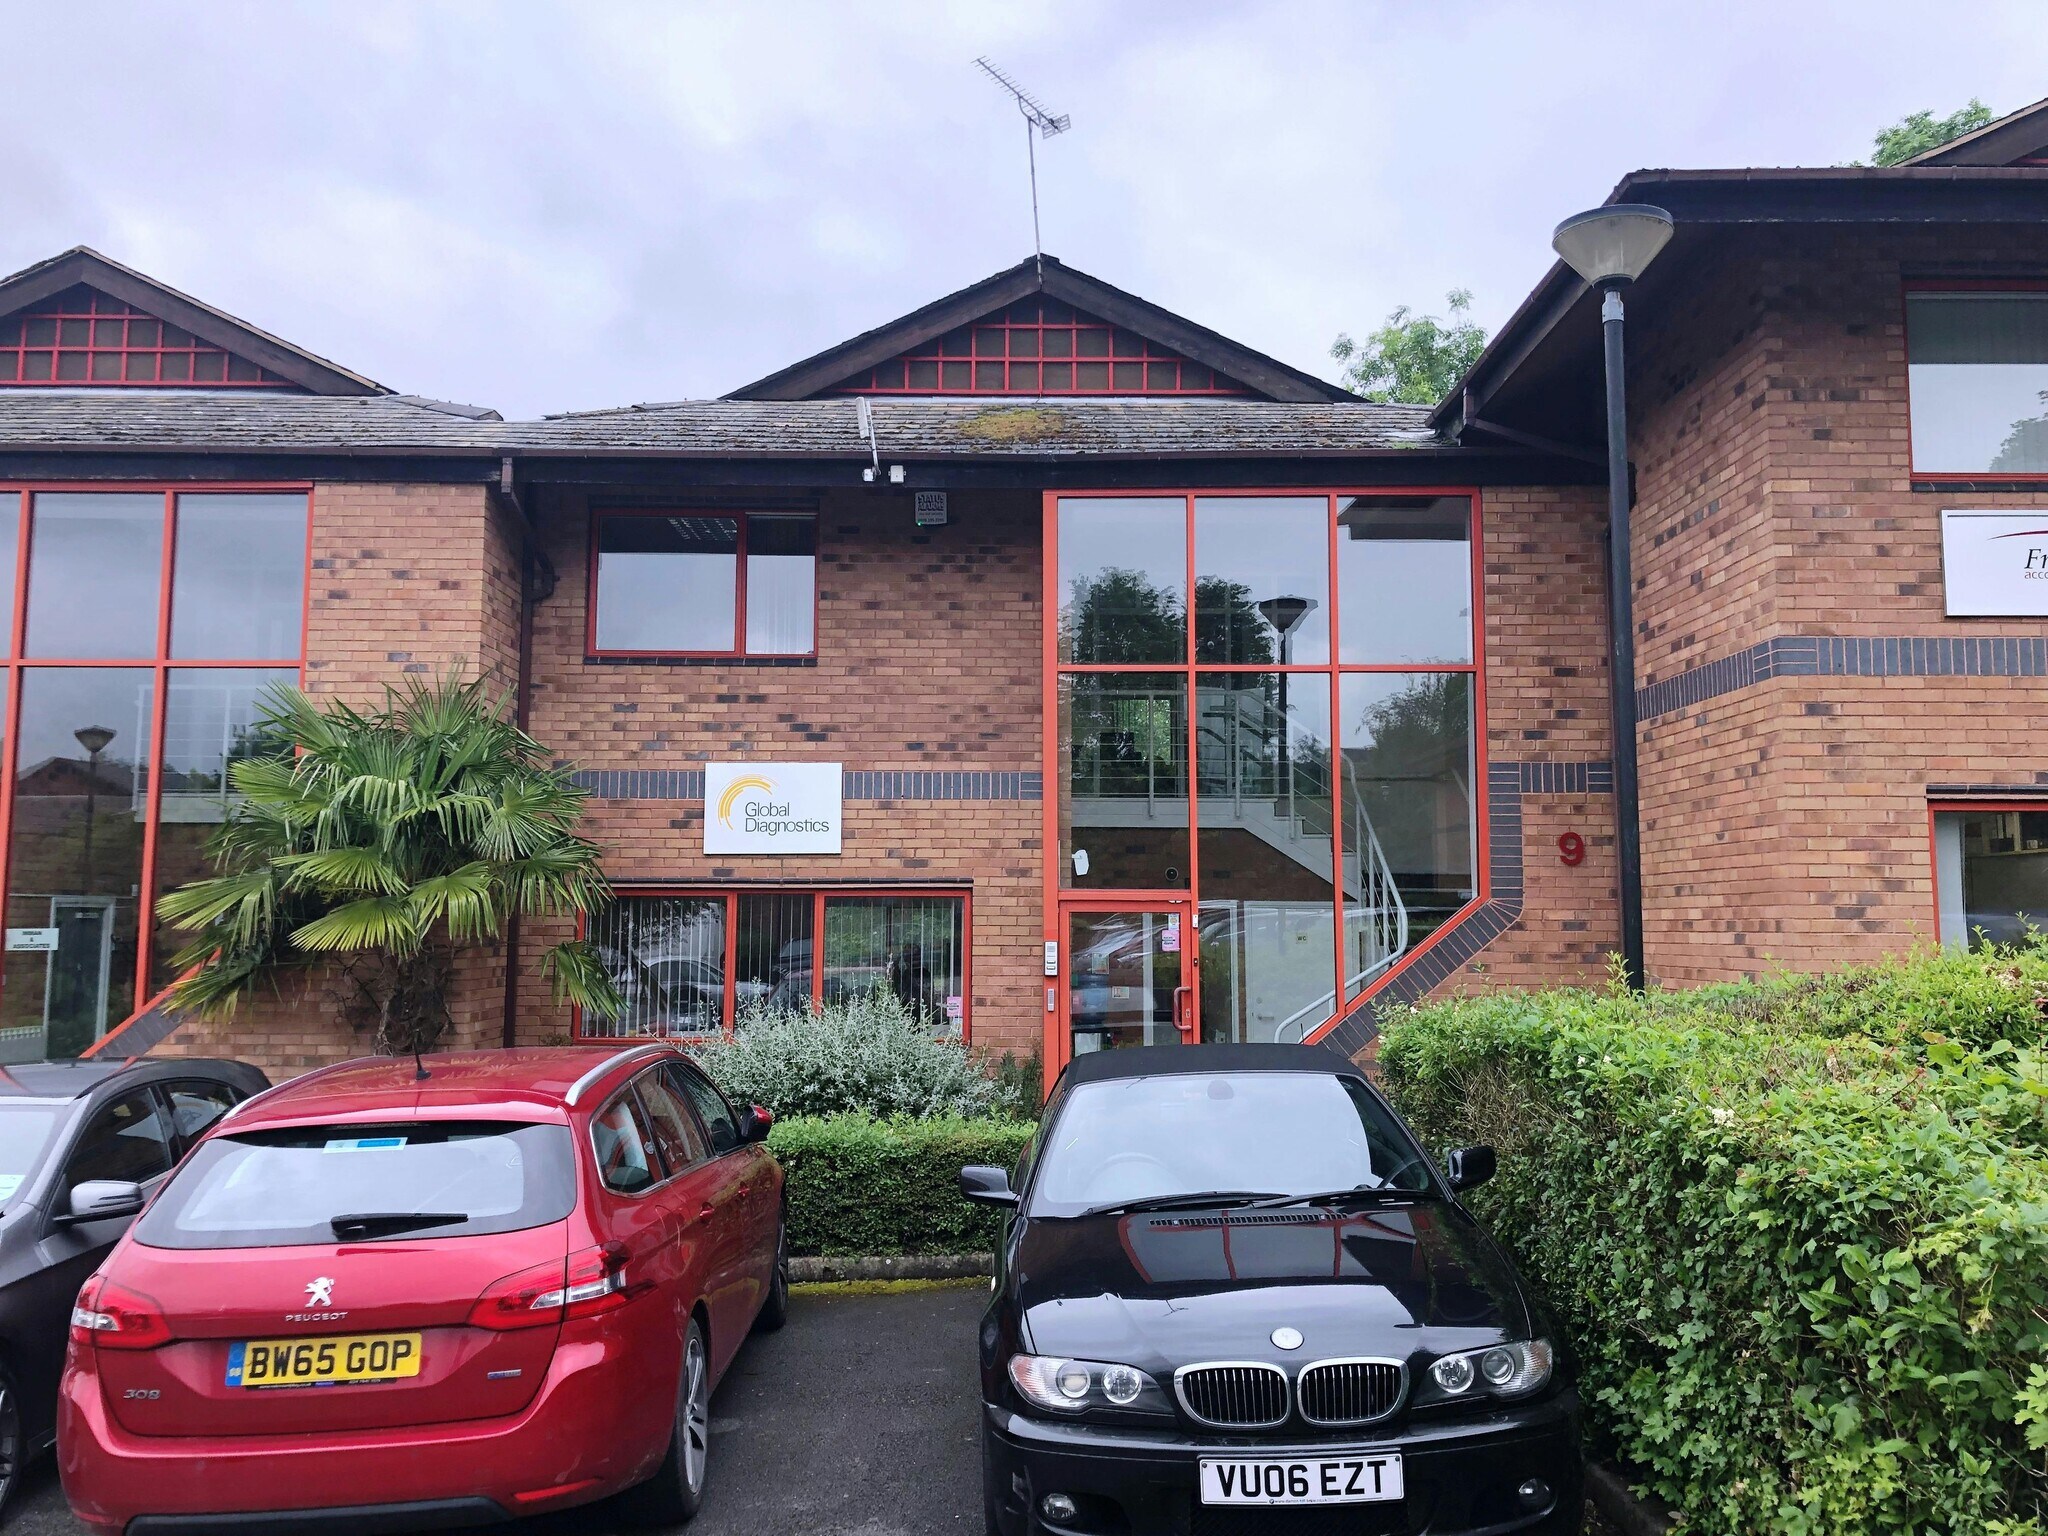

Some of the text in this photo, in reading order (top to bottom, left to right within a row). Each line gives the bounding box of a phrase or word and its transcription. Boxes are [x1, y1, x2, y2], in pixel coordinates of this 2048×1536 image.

[917, 494, 944, 502] STATUS
[745, 801, 790, 817] Global
[745, 818, 830, 836] Diagnostics
[1559, 831, 1585, 867] 9
[285, 1311, 348, 1322] PEUGEOT
[249, 1339, 412, 1379] BW65 GOP
[123, 1389, 161, 1400] 308
[1216, 1460, 1387, 1497] VU06 EZT
